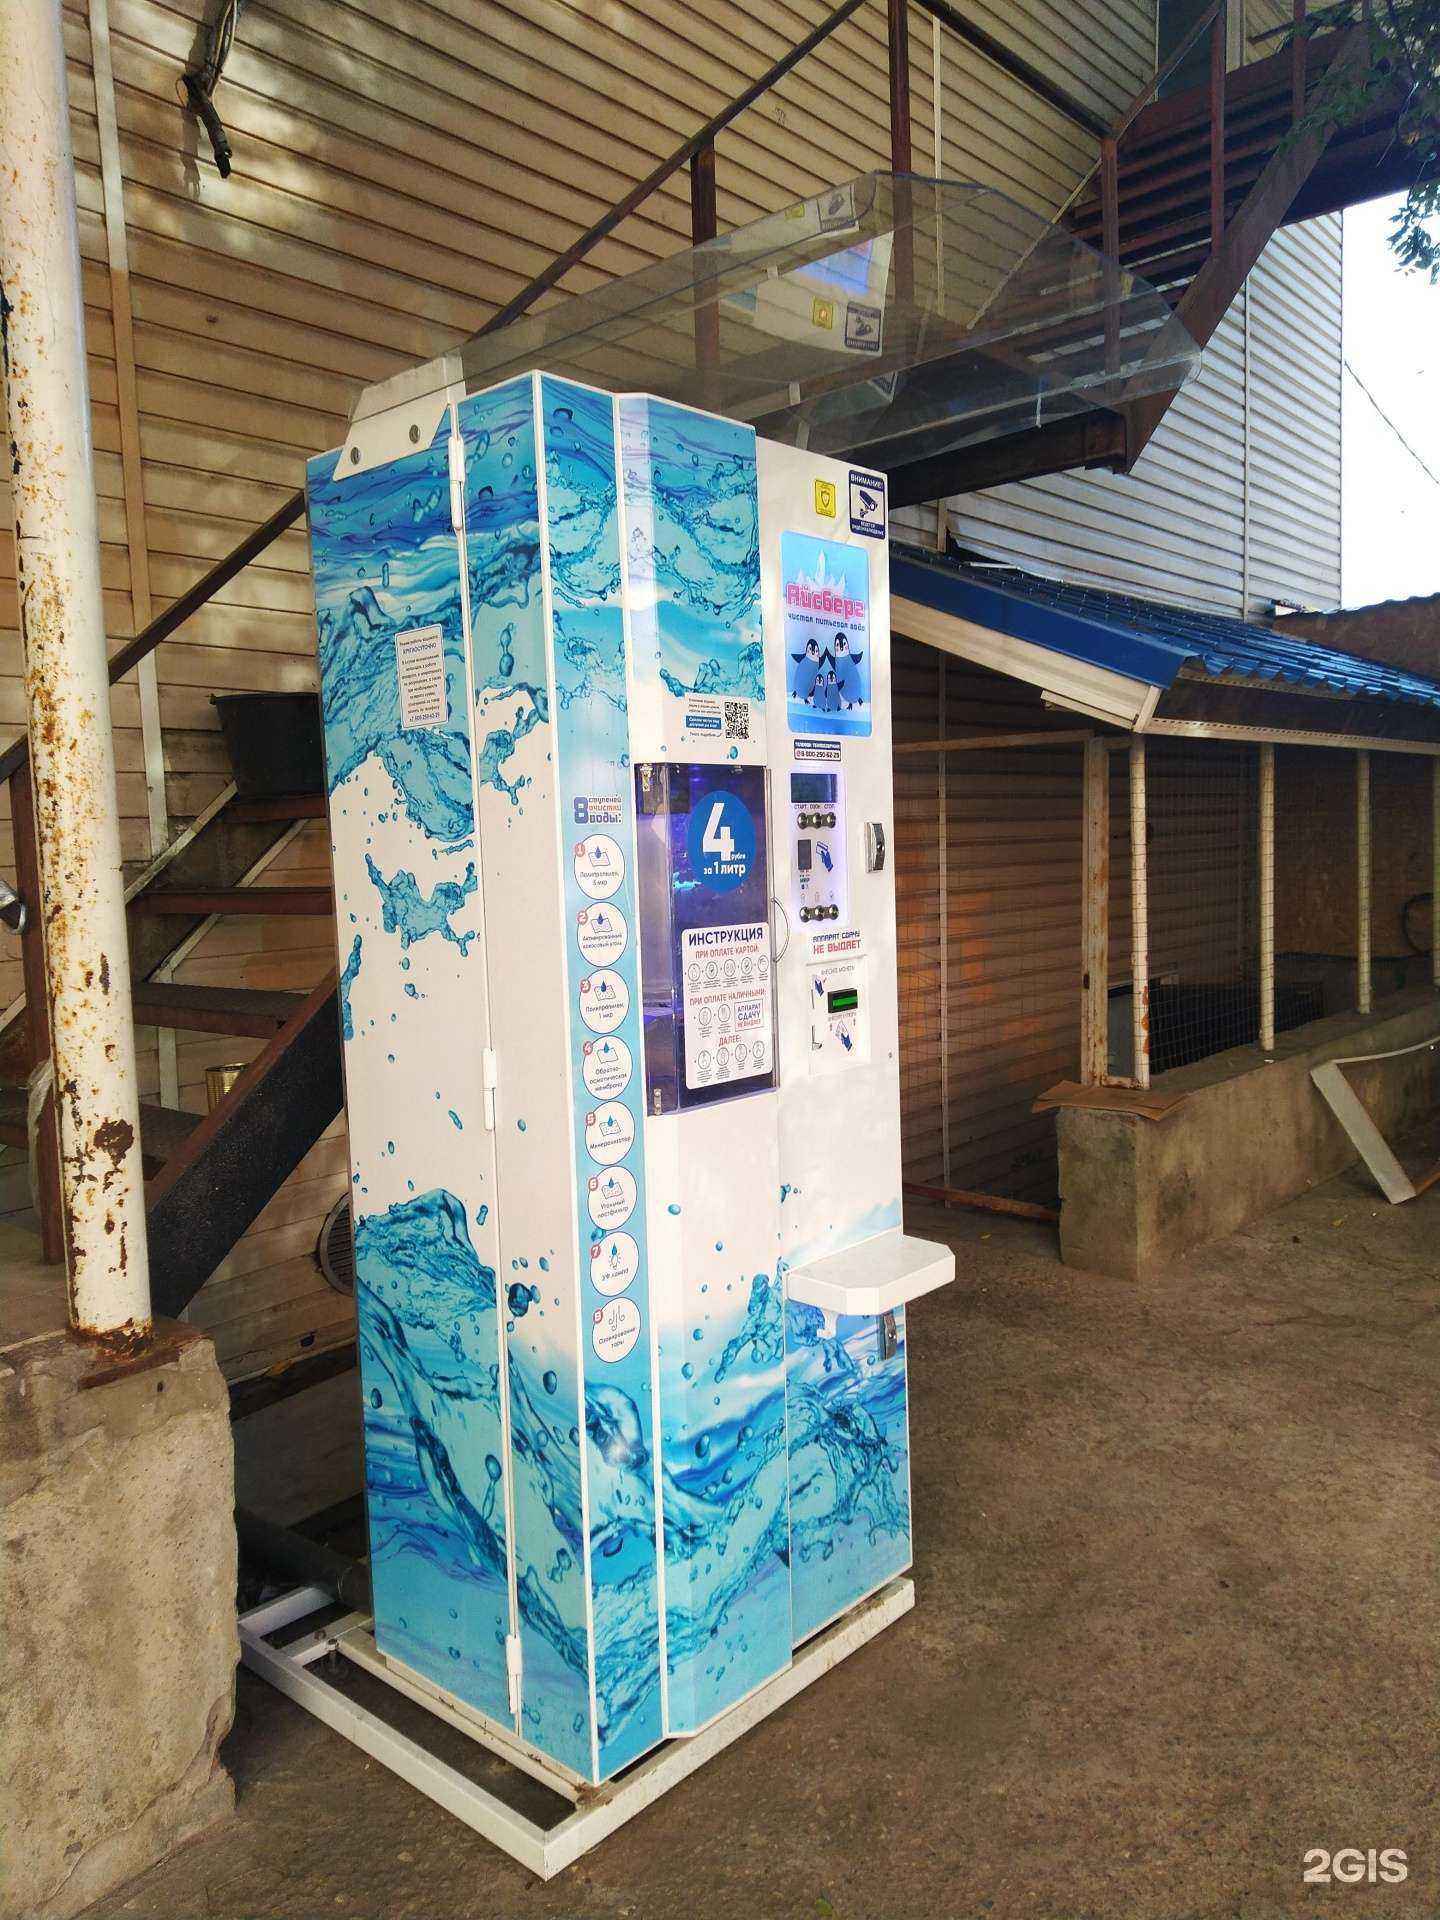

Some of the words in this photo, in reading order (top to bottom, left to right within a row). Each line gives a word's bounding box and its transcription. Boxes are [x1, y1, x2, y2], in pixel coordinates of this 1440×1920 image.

[850, 473, 884, 490] ВНИМАНИЕ!
[786, 583, 864, 619] Айсберг
[788, 612, 813, 623] чистая
[816, 616, 848, 628] питьевая
[850, 623, 865, 631] вода
[574, 796, 588, 824] 8
[589, 794, 621, 804] ступеней
[589, 804, 621, 812] очистки
[589, 813, 622, 824] воды:
[703, 802, 734, 861] 4
[714, 862, 719, 874] 1
[720, 864, 746, 877] литр
[579, 913, 587, 923] 2
[688, 927, 763, 946] ИНСТРУКЦИЯ
[813, 933, 839, 943] АППАРАТ
[696, 950, 708, 959] ПРИ
[709, 947, 734, 957] ОПЛАТЕ
[813, 944, 825, 955] НЕ
[827, 940, 861, 953] ВЫДАЕТ
[690, 997, 702, 1006] ПРИ
[703, 994, 727, 1004] ОПЛАТЕ
[738, 1003, 761, 1012] АППАРАТ
[738, 1010, 761, 1021] СДАЧУ
[587, 1113, 595, 1125] 5
